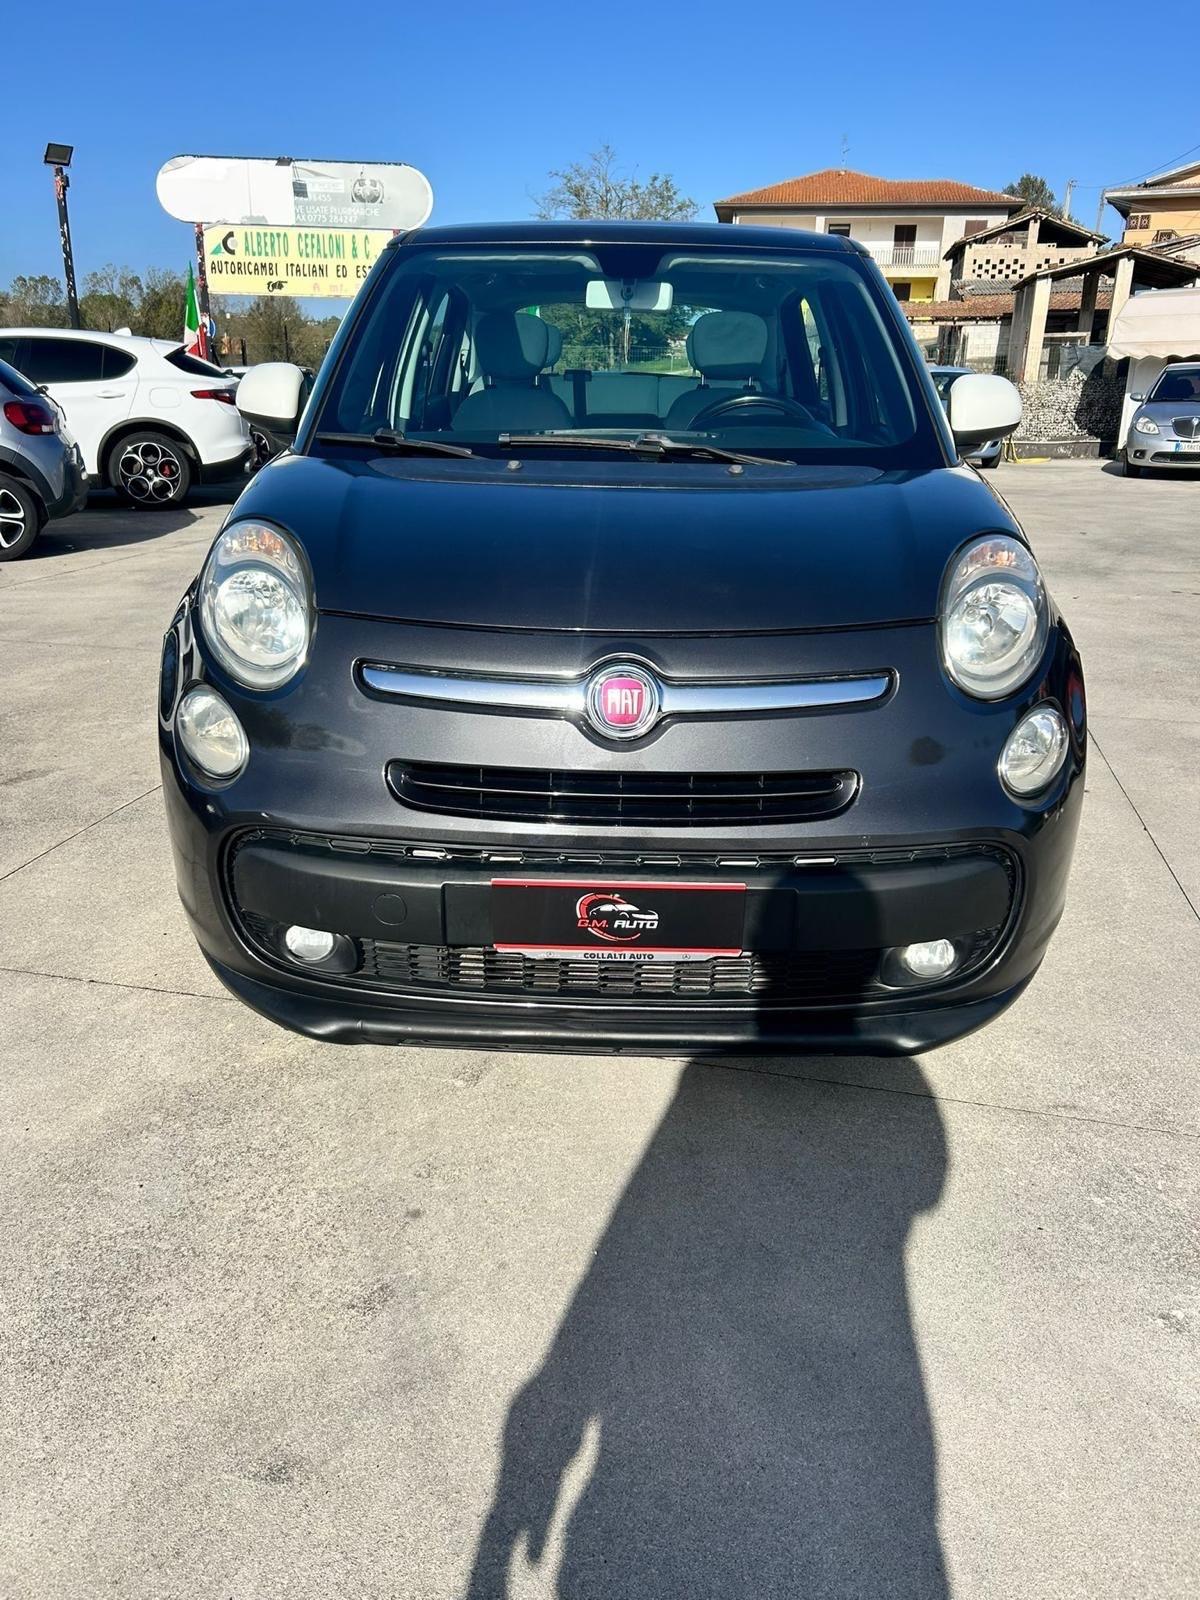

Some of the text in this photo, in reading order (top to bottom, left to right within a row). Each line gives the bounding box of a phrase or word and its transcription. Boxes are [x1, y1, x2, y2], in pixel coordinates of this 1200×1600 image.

[306, 206, 330, 215] USATE
[244, 231, 289, 257] ALBERTO
[297, 232, 345, 259] CEFALONI
[352, 234, 358, 259] &
[210, 260, 279, 276] AUTORICAMBI
[286, 263, 329, 278] ITALIANI
[336, 264, 348, 278] ED
[607, 688, 642, 715] FIAT
[577, 919, 659, 929] G.M. AUTO
[583, 952, 626, 960] COLLALTI
